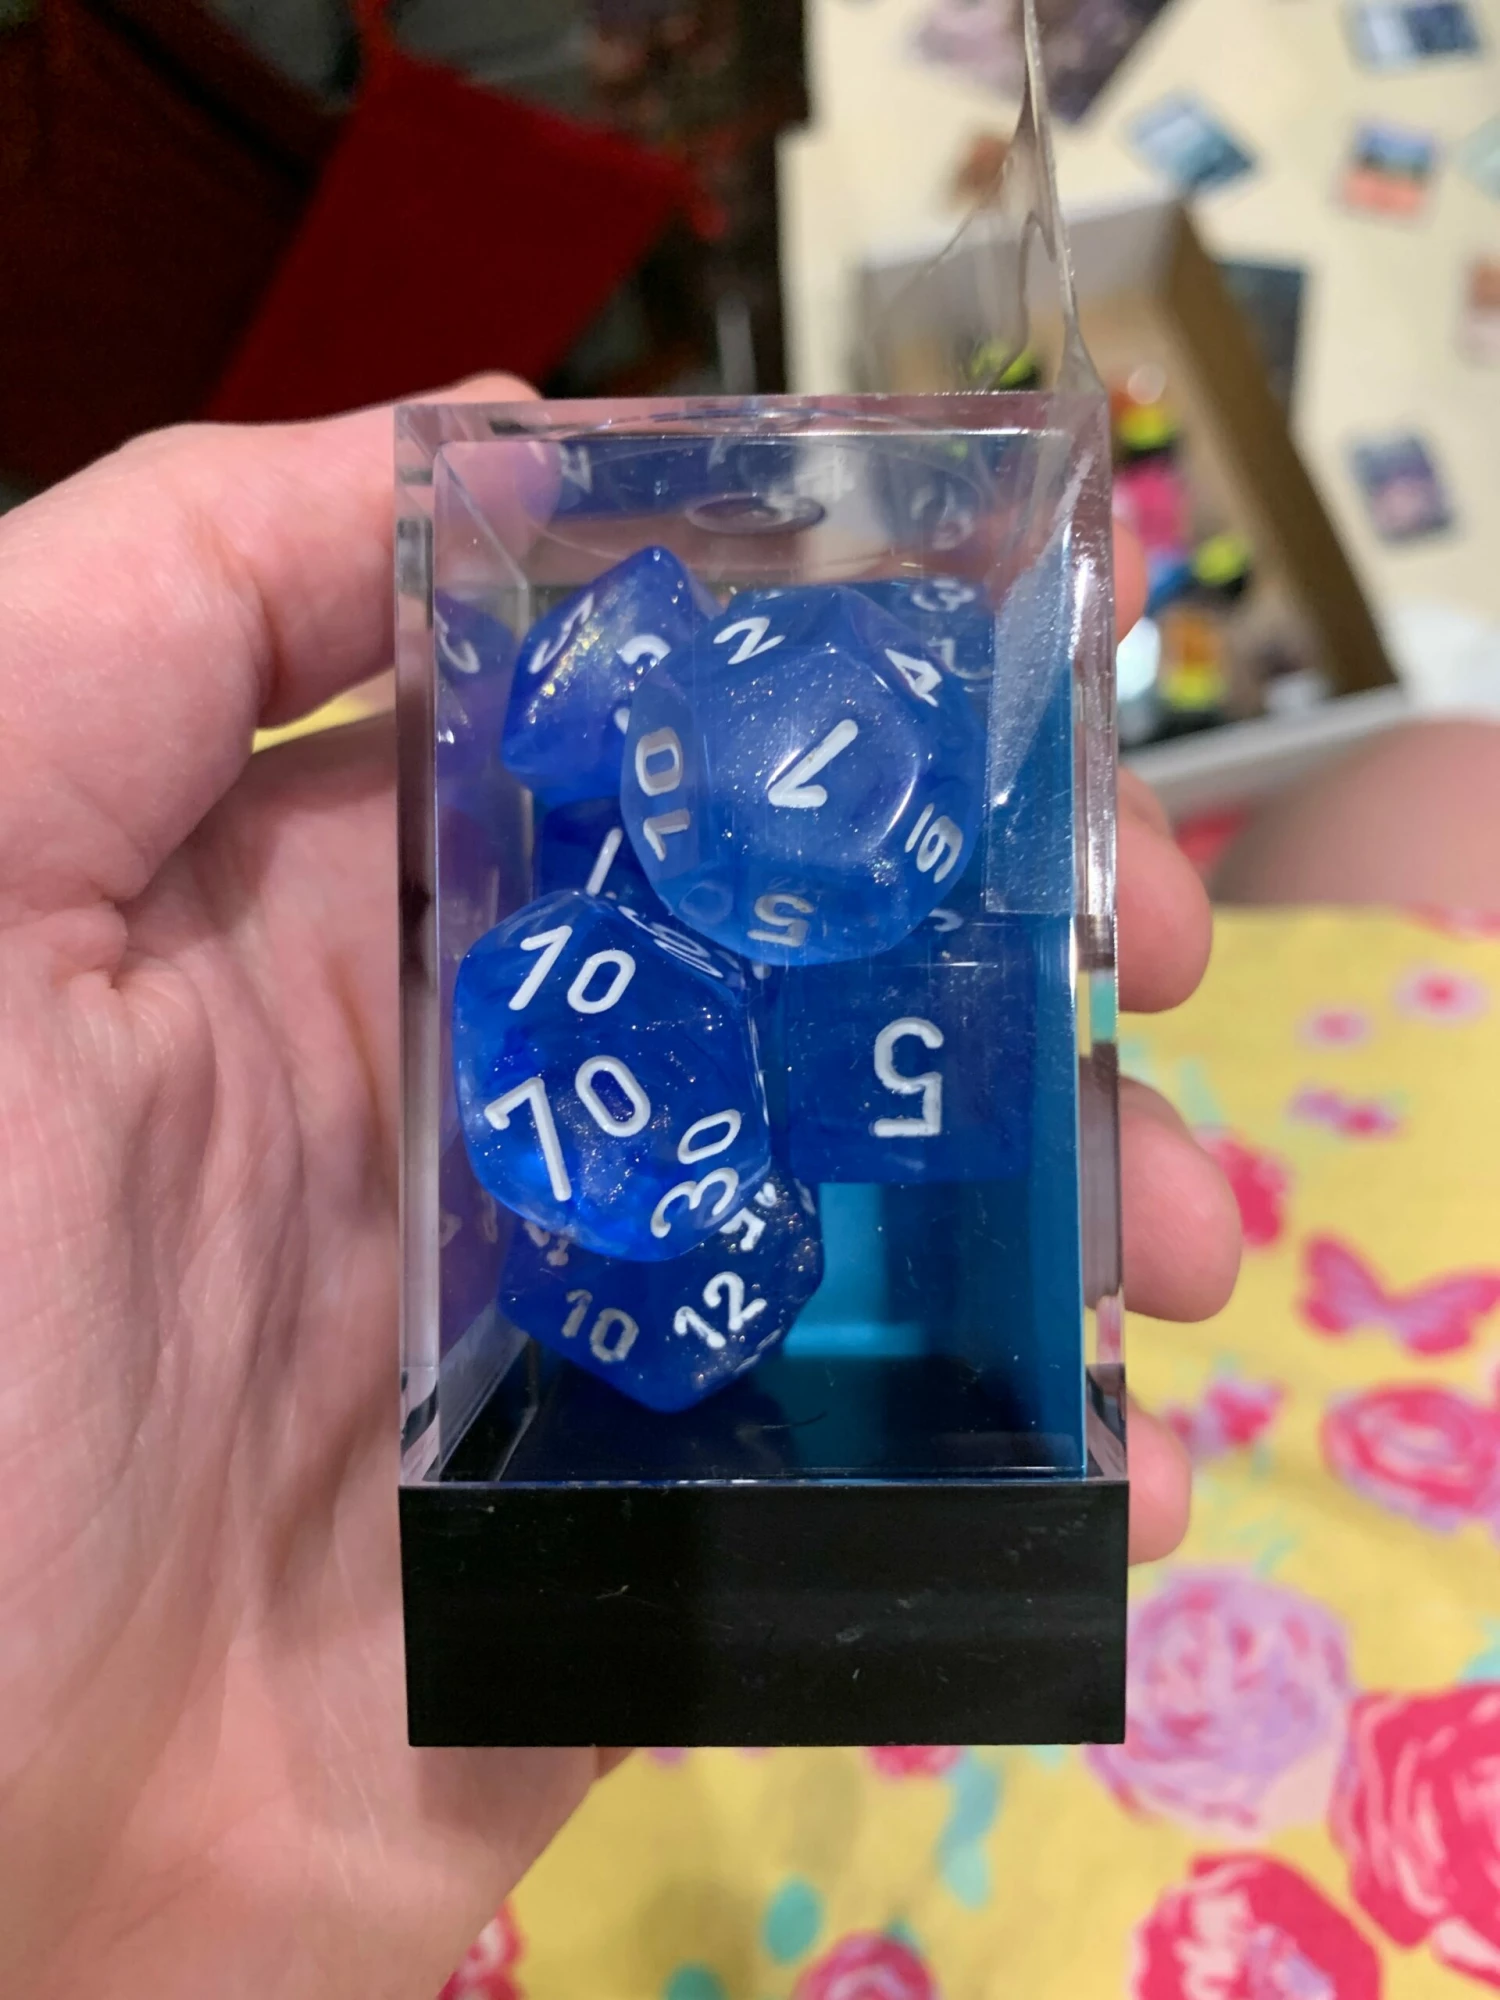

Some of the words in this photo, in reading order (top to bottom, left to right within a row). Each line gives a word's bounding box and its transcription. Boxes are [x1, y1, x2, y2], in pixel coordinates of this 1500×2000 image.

[713, 617, 786, 666] 2
[884, 648, 944, 708] 4
[509, 924, 637, 1014] 10
[873, 1017, 944, 1138] 5
[484, 1055, 651, 1202] 70
[650, 1108, 742, 1239] 30
[562, 1289, 640, 1363] 10
[673, 1271, 768, 1349] 12
